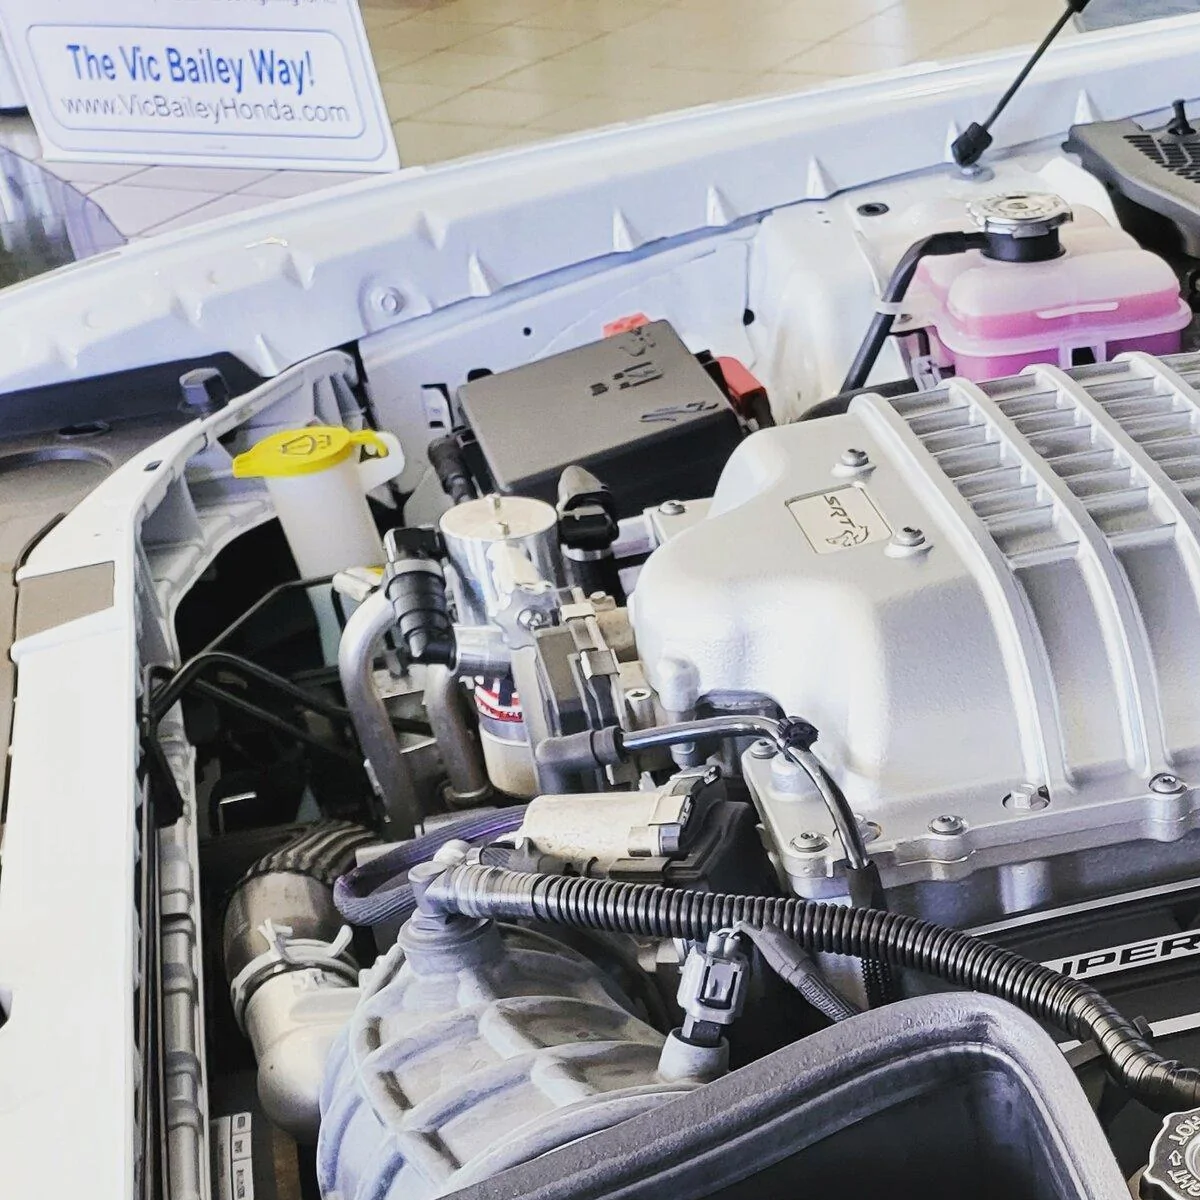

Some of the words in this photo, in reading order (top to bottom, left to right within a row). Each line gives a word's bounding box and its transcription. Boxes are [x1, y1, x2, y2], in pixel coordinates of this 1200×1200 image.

[66, 44, 116, 80] The
[118, 45, 161, 81] Vic
[165, 47, 243, 94] Bailey
[248, 48, 314, 96] Way!
[60, 94, 350, 124] www.VicBaileyHonda.com
[823, 495, 856, 528] SRT
